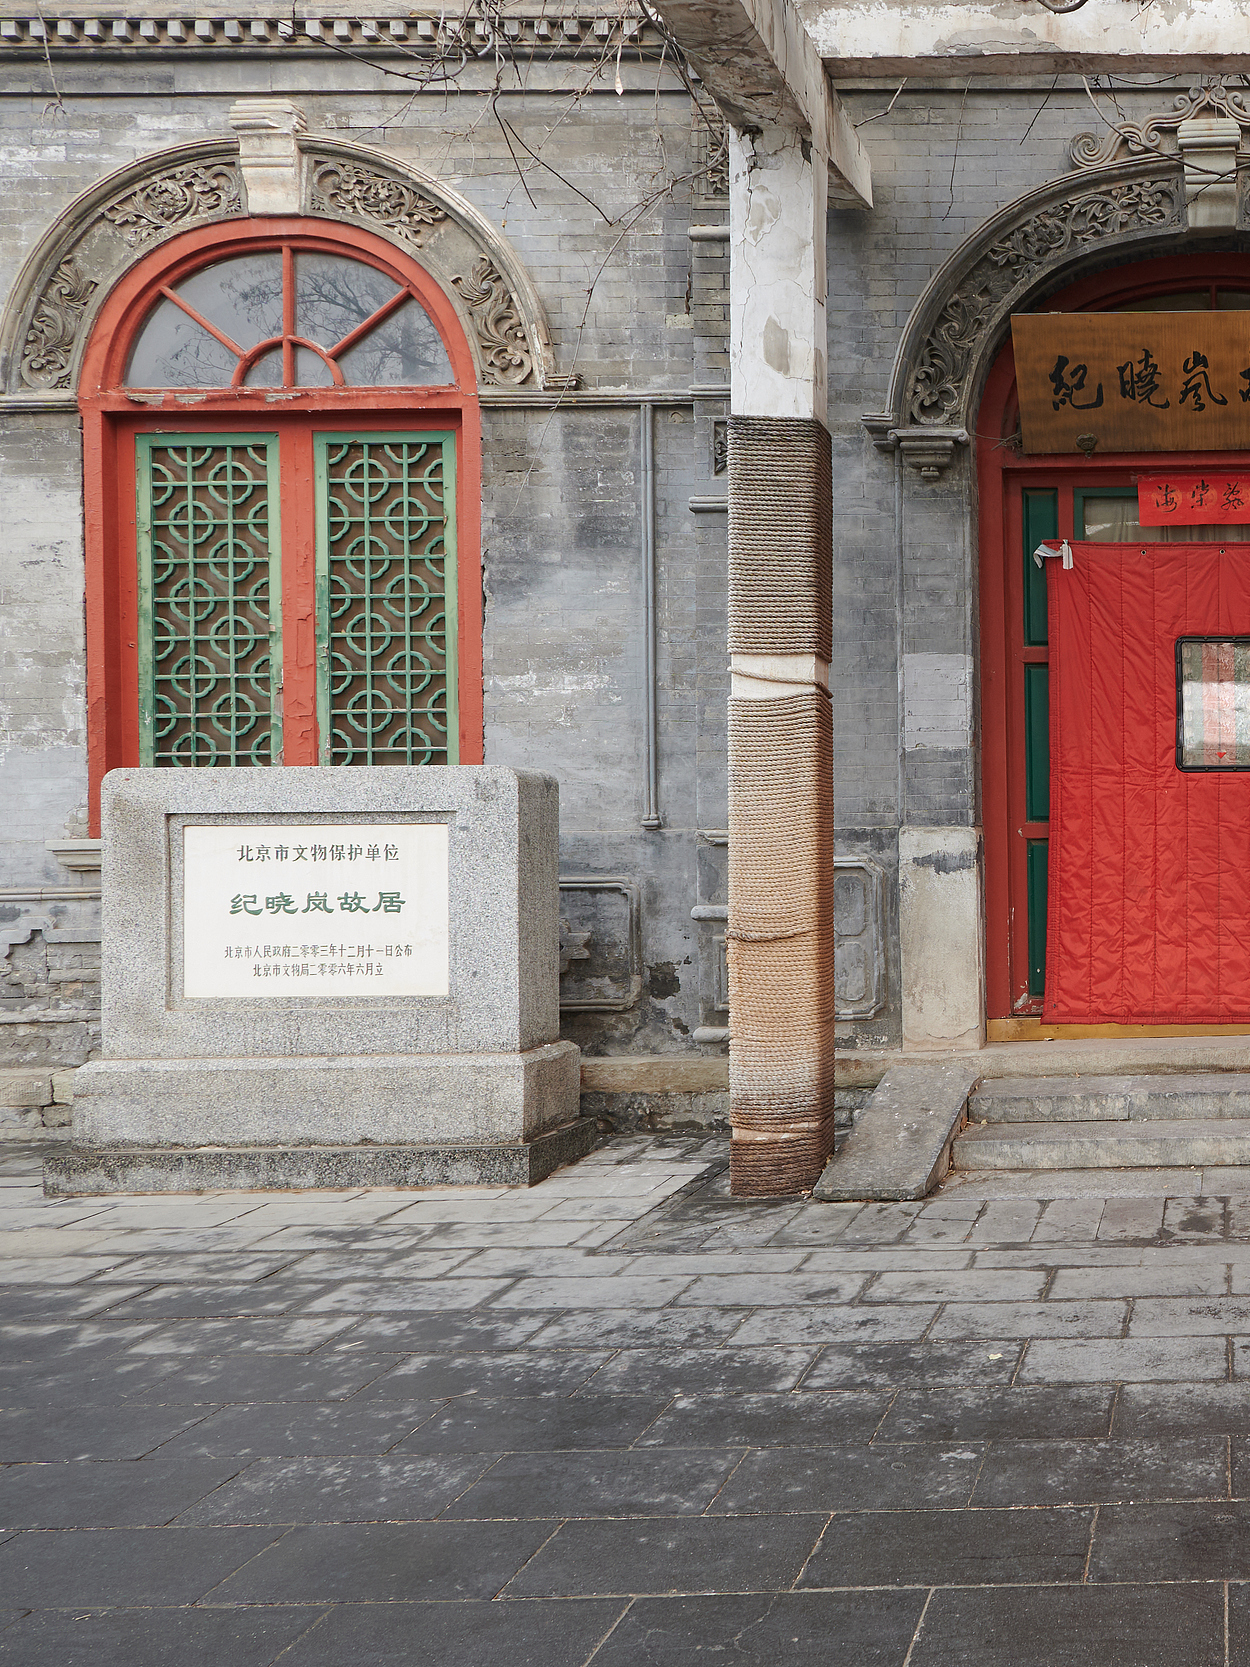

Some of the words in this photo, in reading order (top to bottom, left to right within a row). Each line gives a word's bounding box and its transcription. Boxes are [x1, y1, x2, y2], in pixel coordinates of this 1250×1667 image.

[236, 844, 400, 862] 北京市文物保护单位
[229, 891, 406, 916] 纪晓岚故居
[224, 944, 413, 959] 北京市人民政府二零零三年十二月十一日公布
[253, 962, 384, 977] 北京市文物局二零零六年六月立
